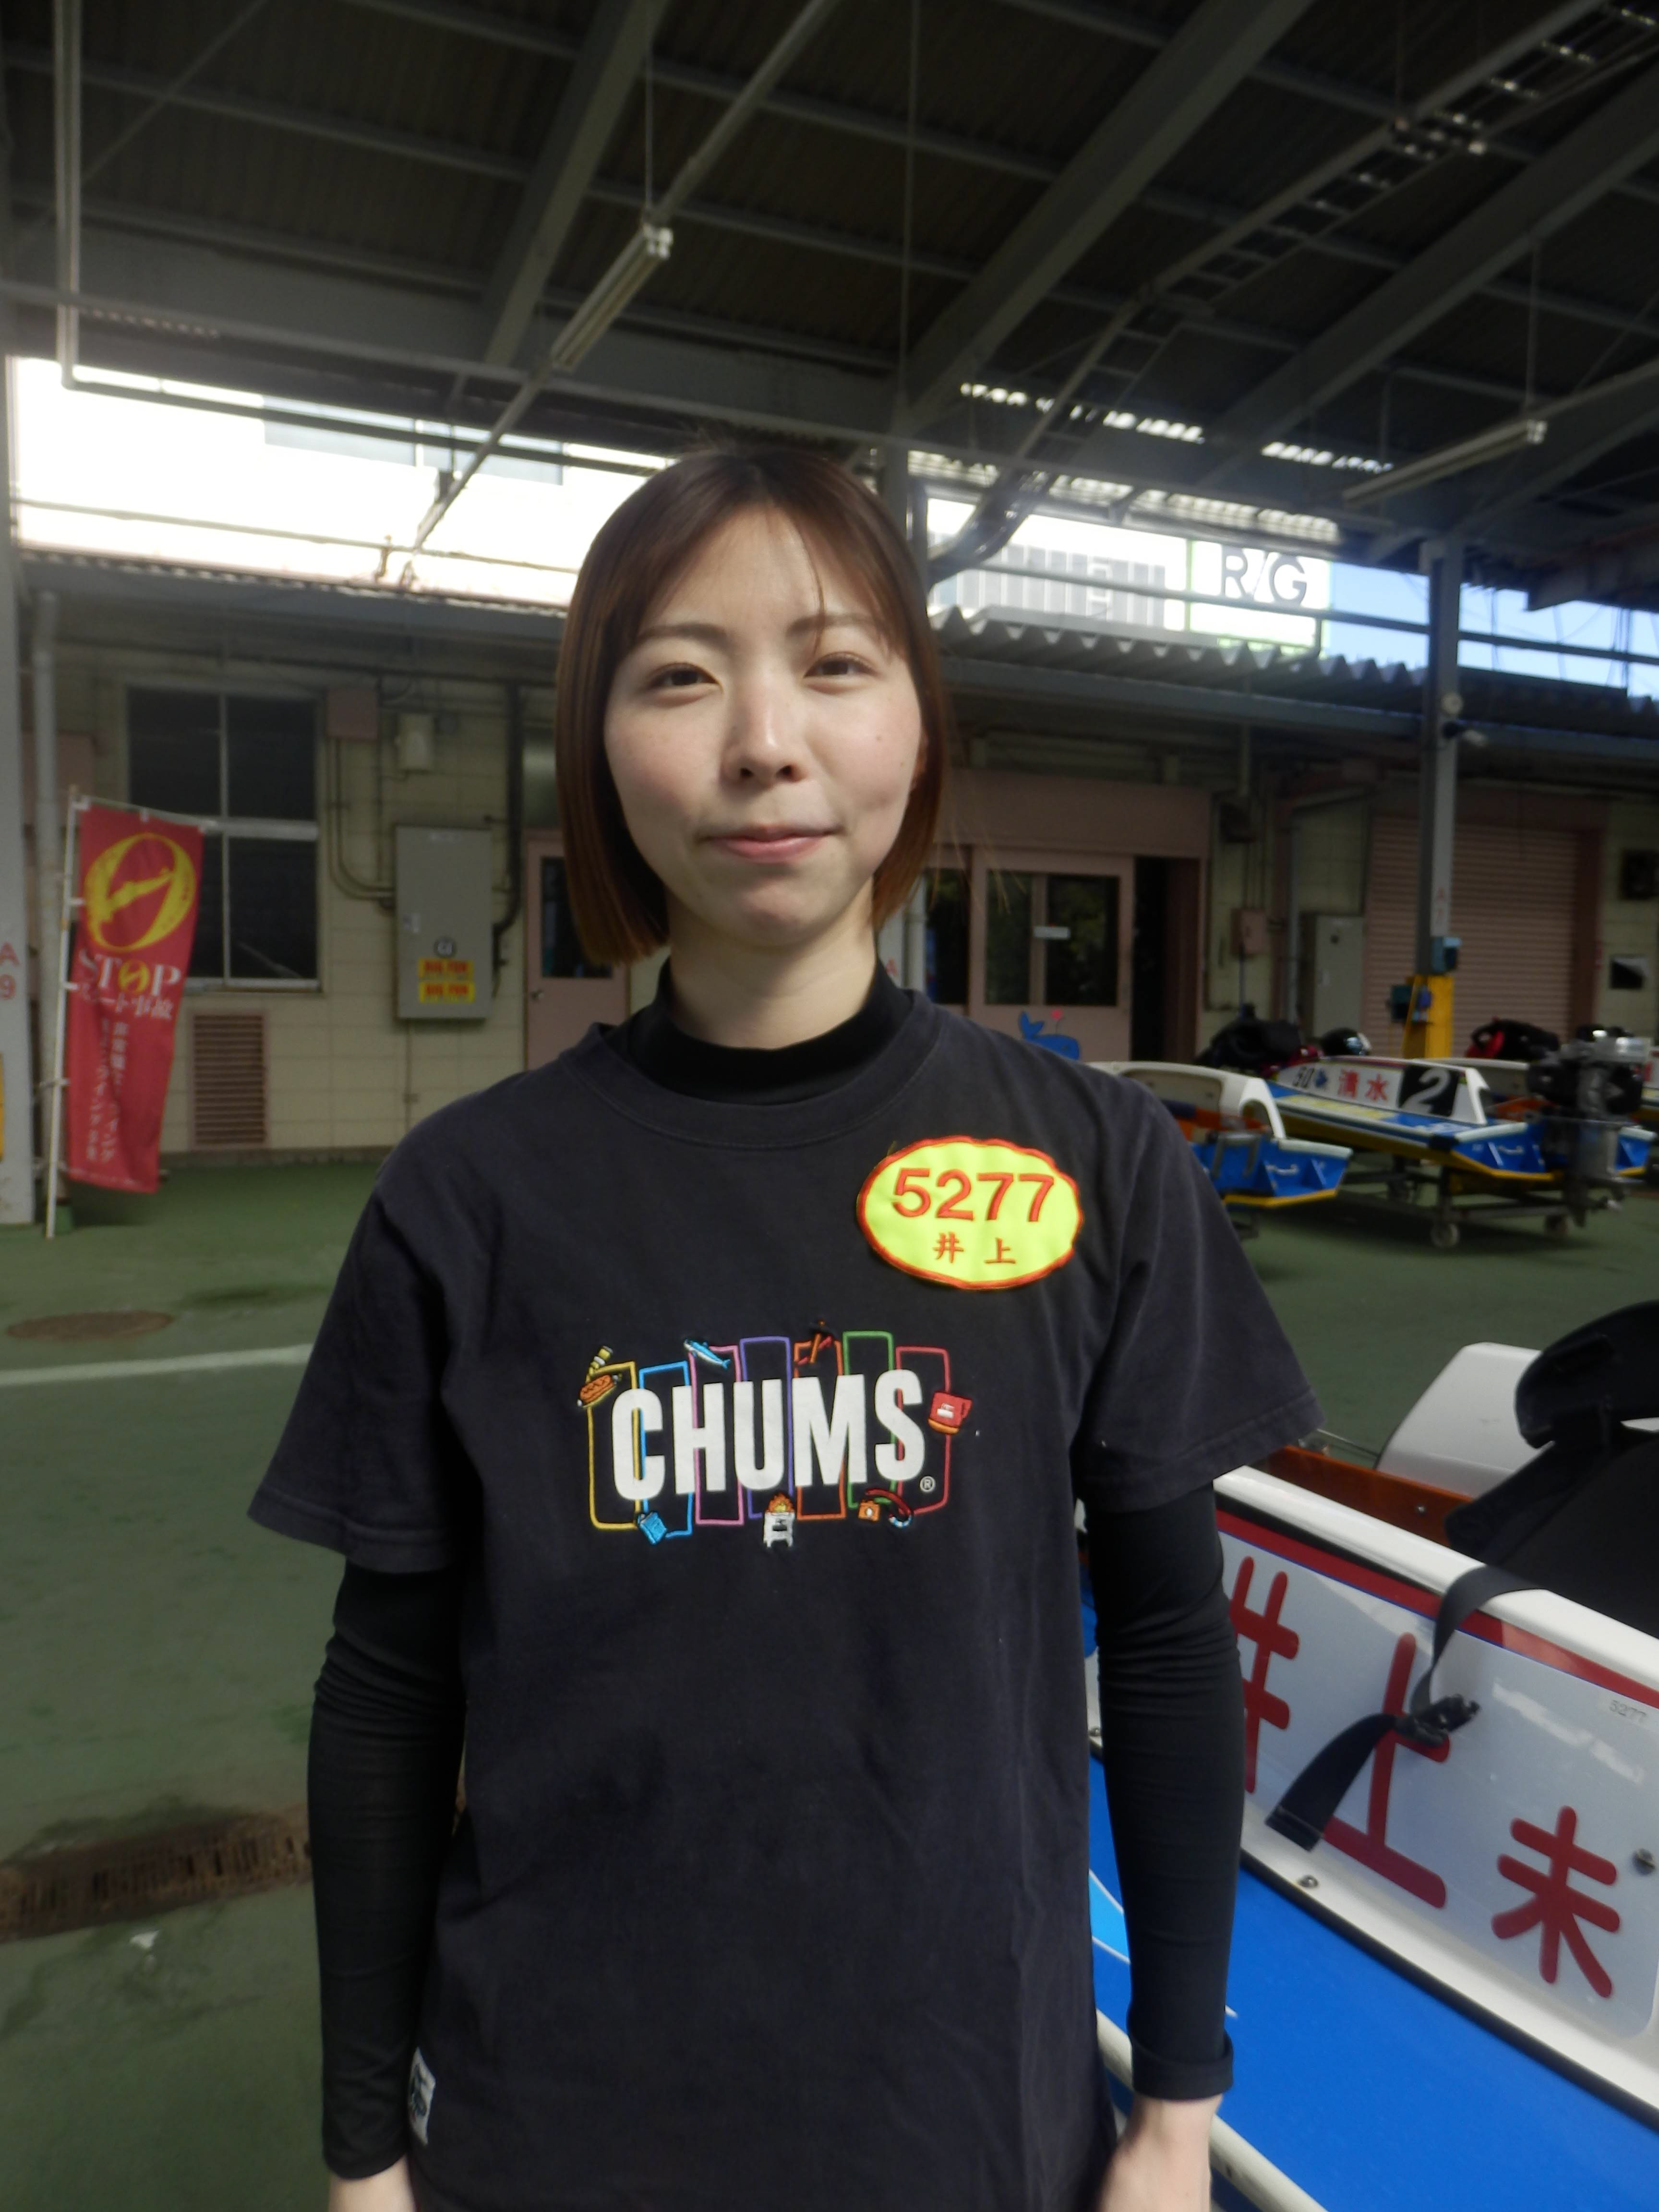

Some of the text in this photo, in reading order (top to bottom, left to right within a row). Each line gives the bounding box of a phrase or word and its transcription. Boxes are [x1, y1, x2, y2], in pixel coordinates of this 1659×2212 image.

[1221, 546, 1307, 606] R/G
[1338, 1069, 1388, 1101] 清水
[1399, 1067, 1450, 1115] 2
[893, 1167, 1056, 1223] 5277
[933, 1231, 1016, 1265] 井上
[612, 1369, 926, 1501] CHUMS
